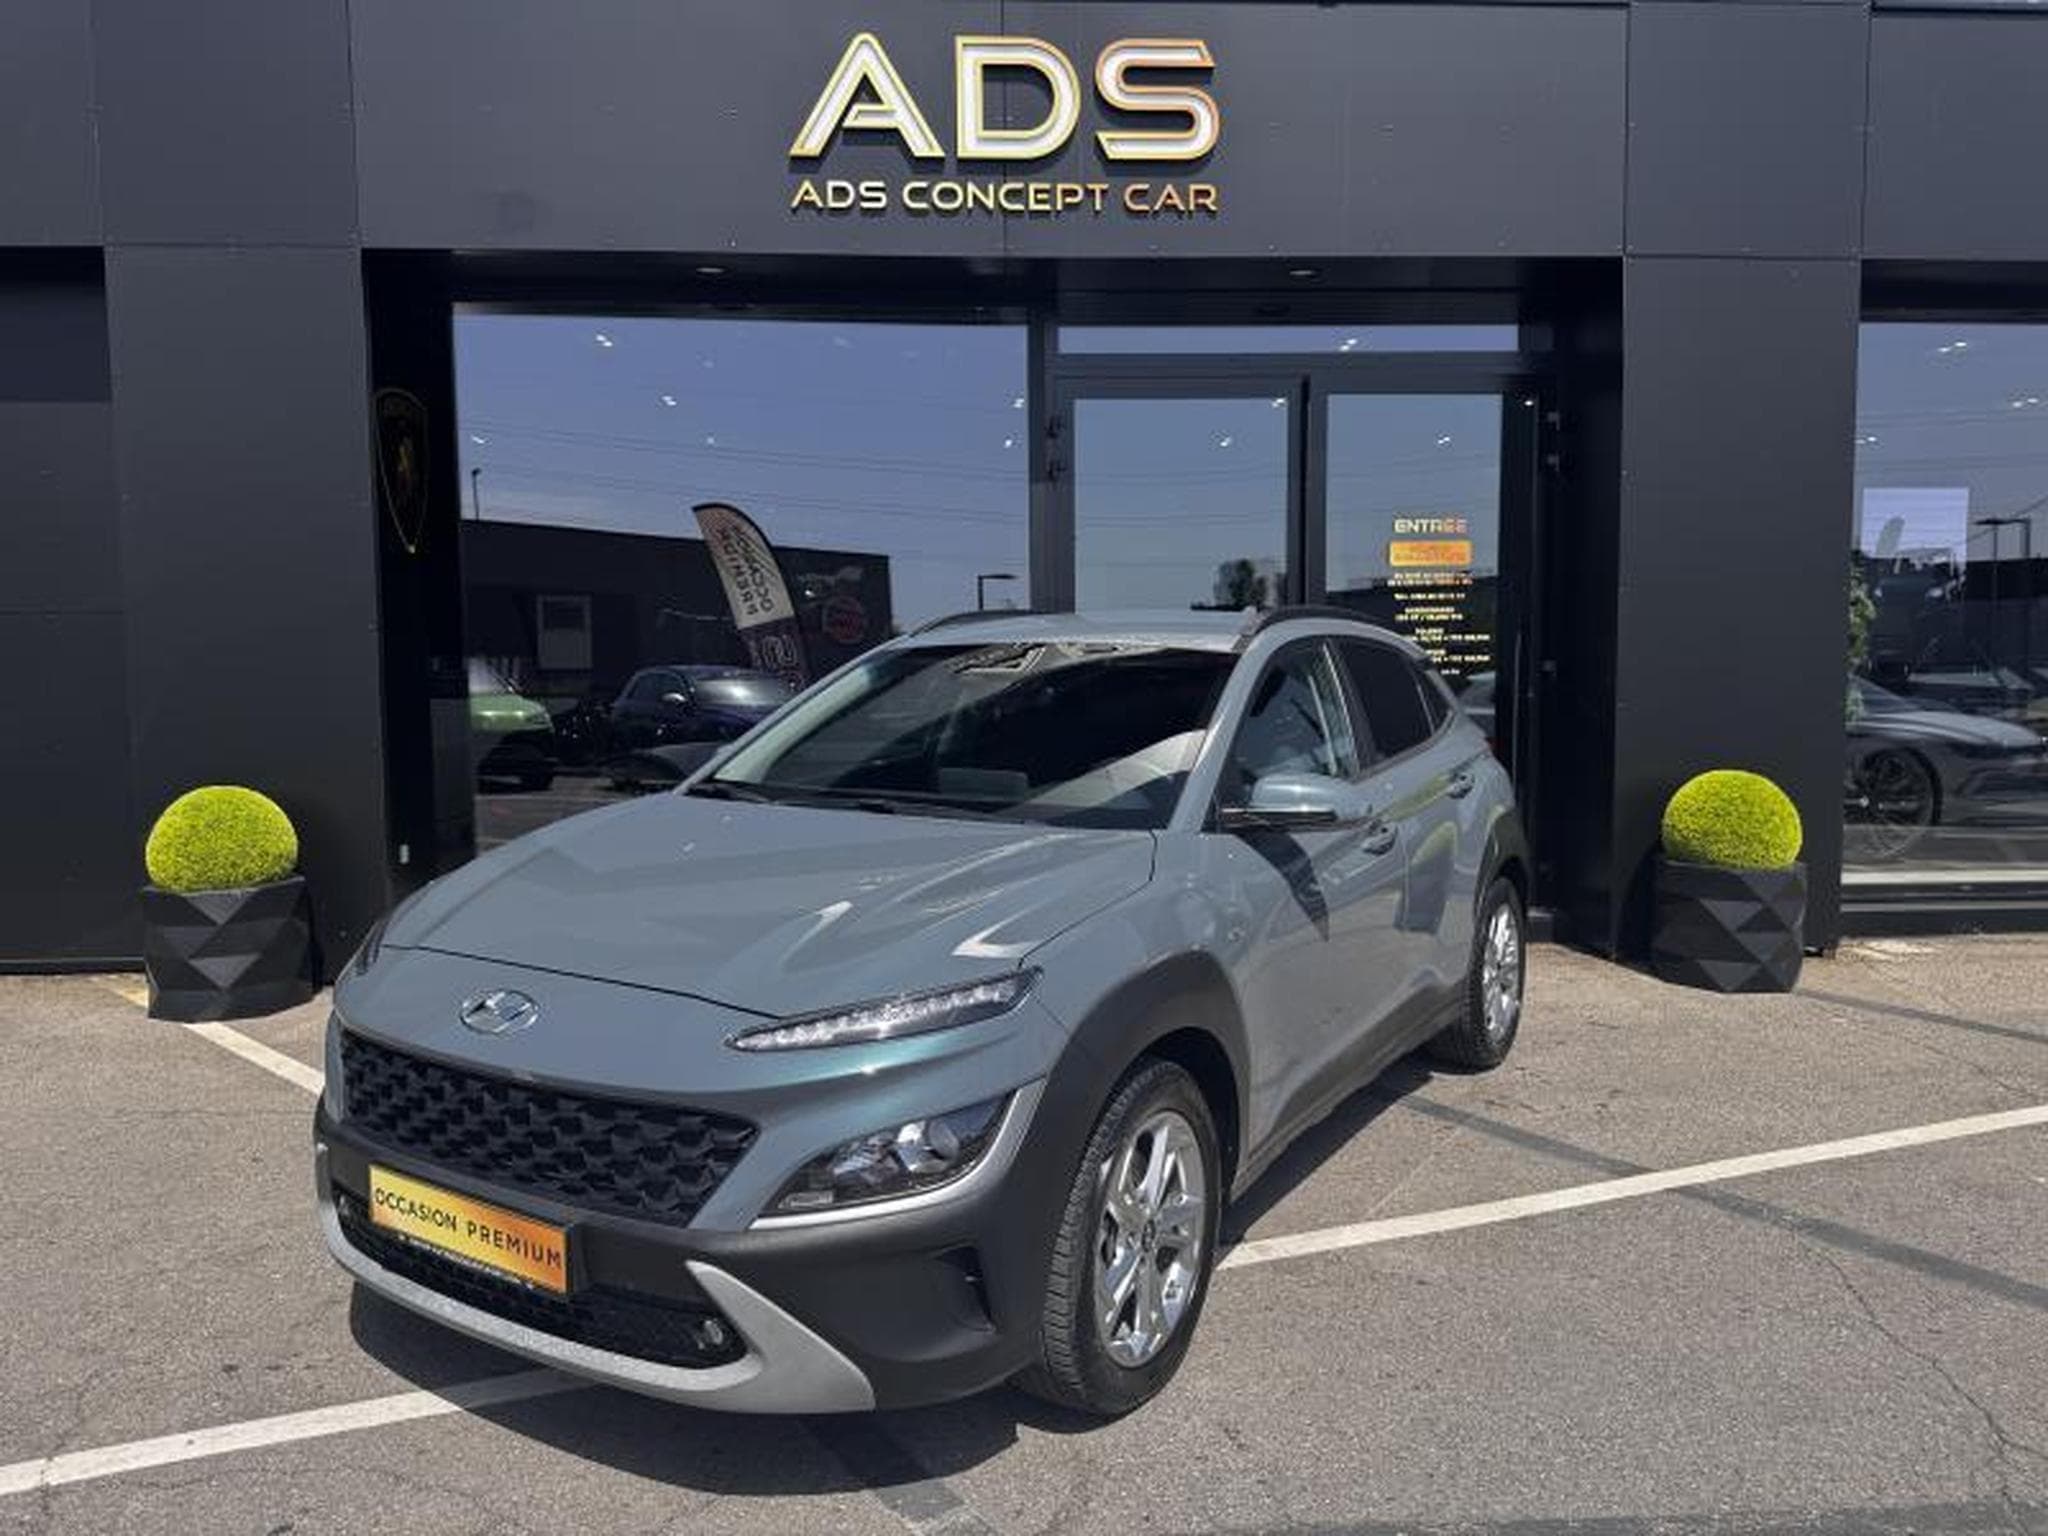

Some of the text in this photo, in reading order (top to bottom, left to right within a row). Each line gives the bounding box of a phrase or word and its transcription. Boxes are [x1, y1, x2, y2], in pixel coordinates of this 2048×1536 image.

[789, 32, 1220, 160] ADS
[791, 179, 1218, 212] ADS CONCEPT CAR
[374, 1186, 562, 1268] OCCASION PREMIUM
